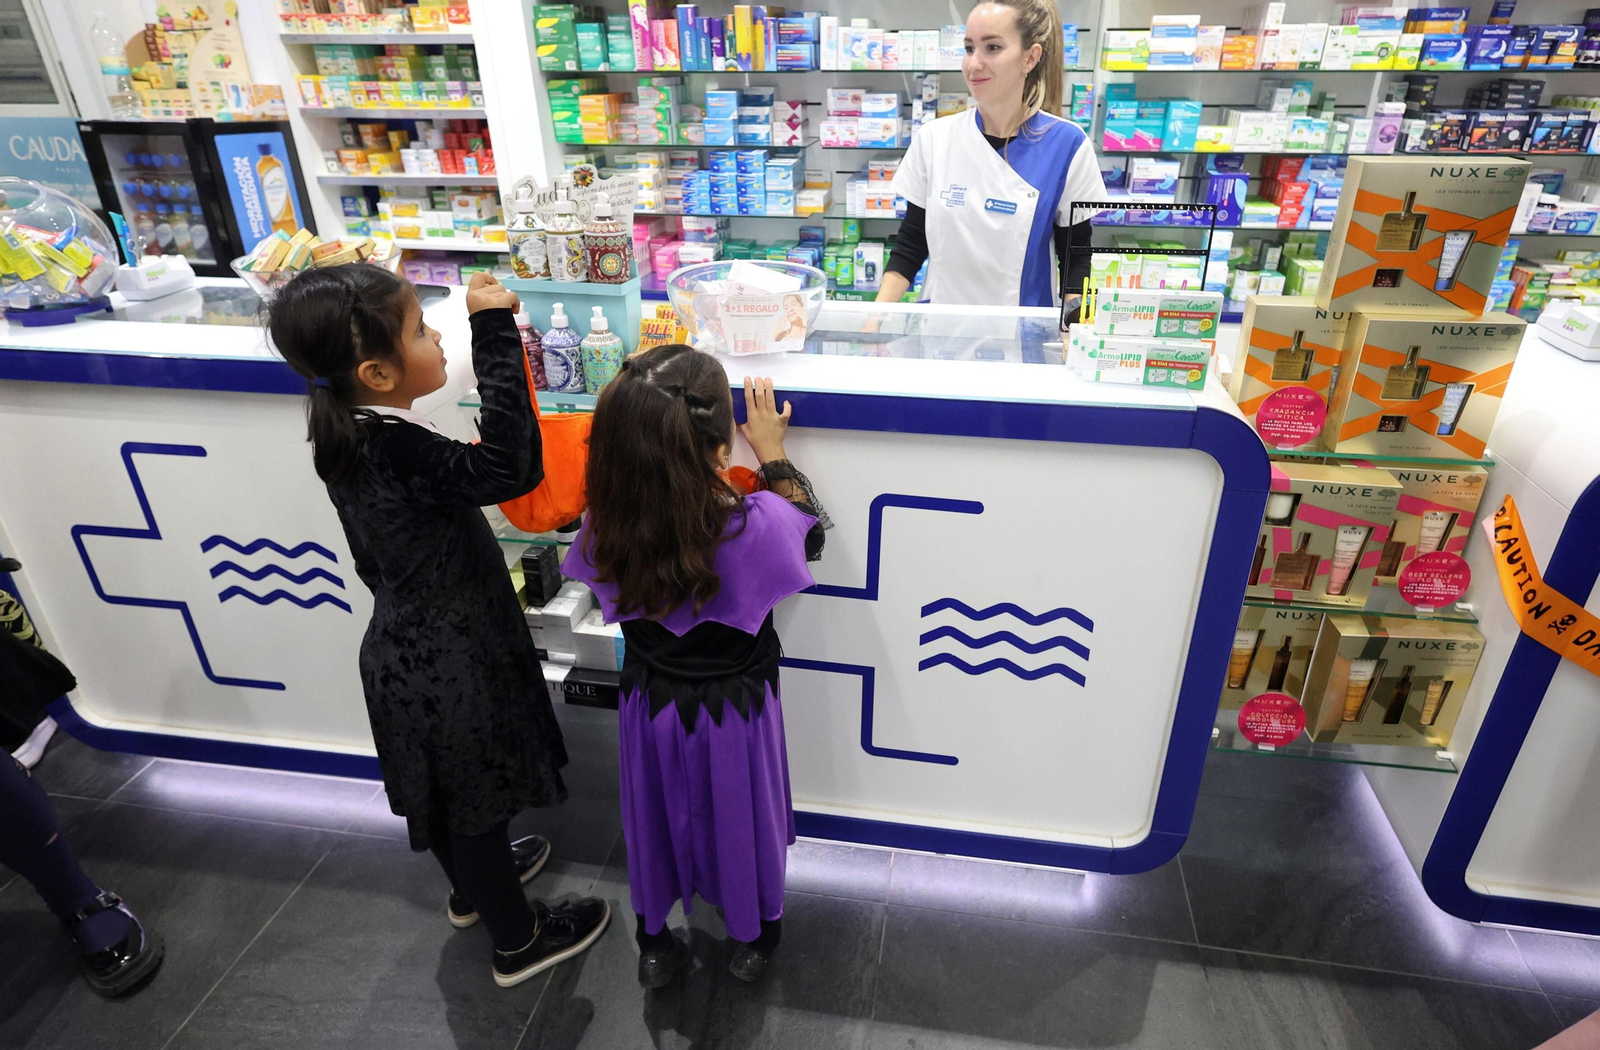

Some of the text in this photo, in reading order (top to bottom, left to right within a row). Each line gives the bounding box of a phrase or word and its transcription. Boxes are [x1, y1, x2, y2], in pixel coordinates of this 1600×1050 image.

[1430, 167, 1498, 178] NUXE
[725, 304, 780, 313] 1+1 REGALO
[1112, 304, 1155, 313] ArmoLIPID
[1133, 312, 1154, 320] PLUS
[646, 322, 672, 334] BEE
[1431, 325, 1497, 336] NUXE
[1097, 351, 1142, 361] ArmoLIPID
[1119, 360, 1141, 369] PLUS
[1275, 392, 1305, 400] NUXE
[1269, 408, 1315, 416] FRAGANCIA
[1277, 413, 1305, 421] MÍTICA
[1398, 472, 1459, 484] NUXE
[1312, 484, 1373, 498] NUXE
[1494, 523, 1552, 620] CAUTION
[1398, 641, 1457, 651] NUXE
[1250, 711, 1294, 719] COLECCIÓN
